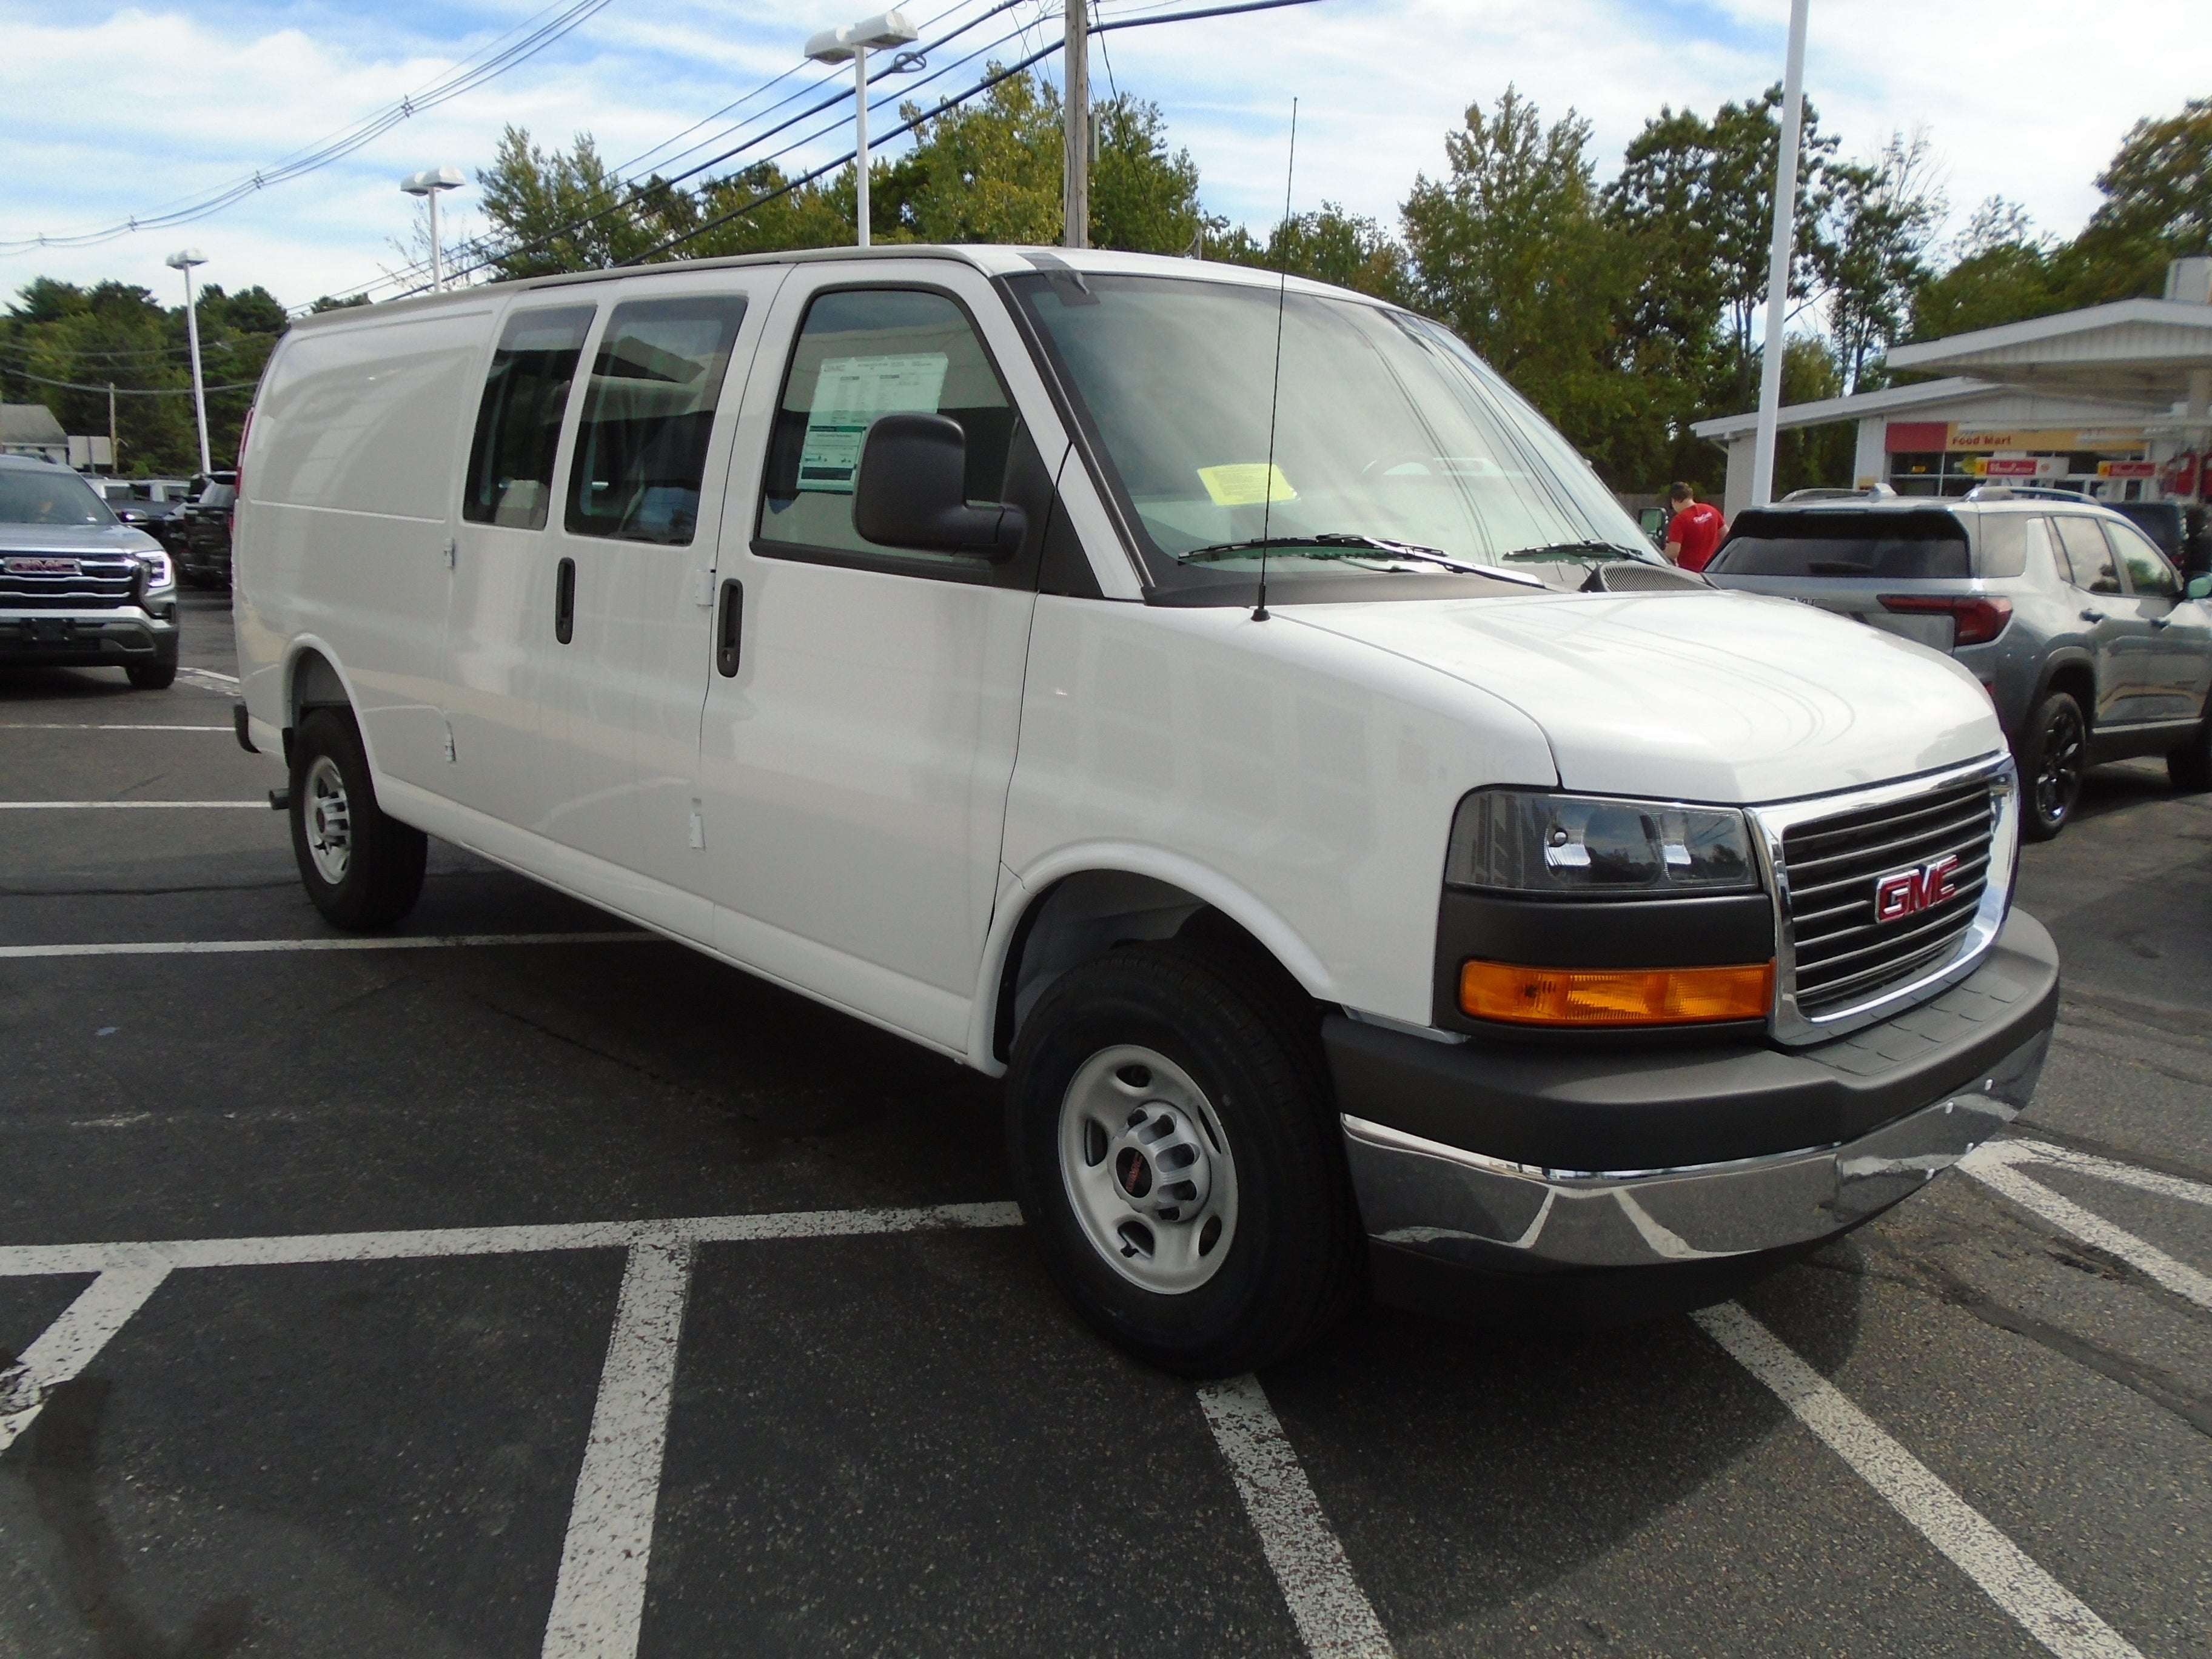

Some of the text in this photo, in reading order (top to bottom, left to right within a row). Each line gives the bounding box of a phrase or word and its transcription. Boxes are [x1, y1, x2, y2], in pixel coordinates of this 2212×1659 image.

[1984, 435, 2011, 445] Mart
[10, 559, 76, 572] GMC
[1875, 854, 1958, 923] GMC
[1125, 1151, 1144, 1193] GMC
